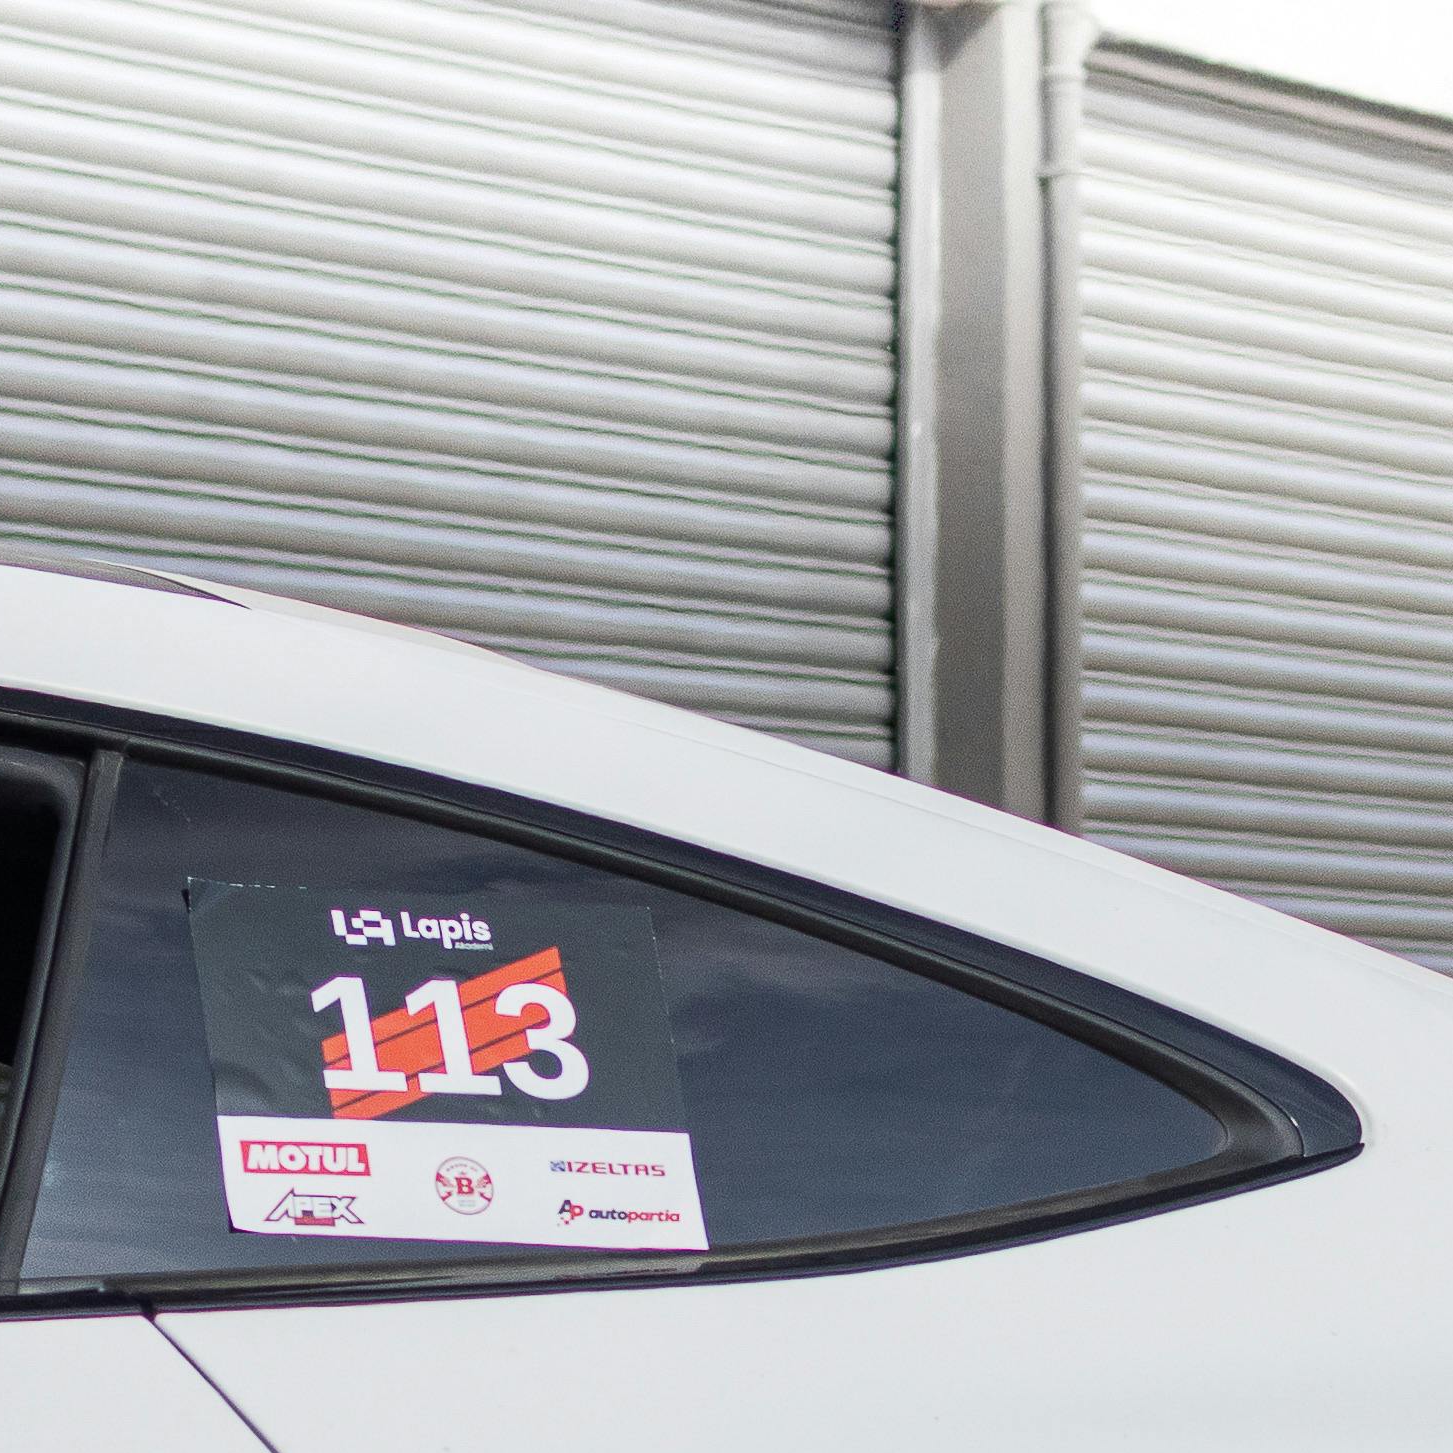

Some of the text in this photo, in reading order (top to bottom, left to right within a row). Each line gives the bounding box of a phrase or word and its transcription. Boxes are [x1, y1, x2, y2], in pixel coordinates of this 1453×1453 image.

[400, 911, 492, 949] Lapis
[310, 976, 590, 1101] 113
[248, 1143, 366, 1173] MOTUL
[264, 1188, 365, 1225] APEX
[589, 1208, 680, 1223] autopartia
